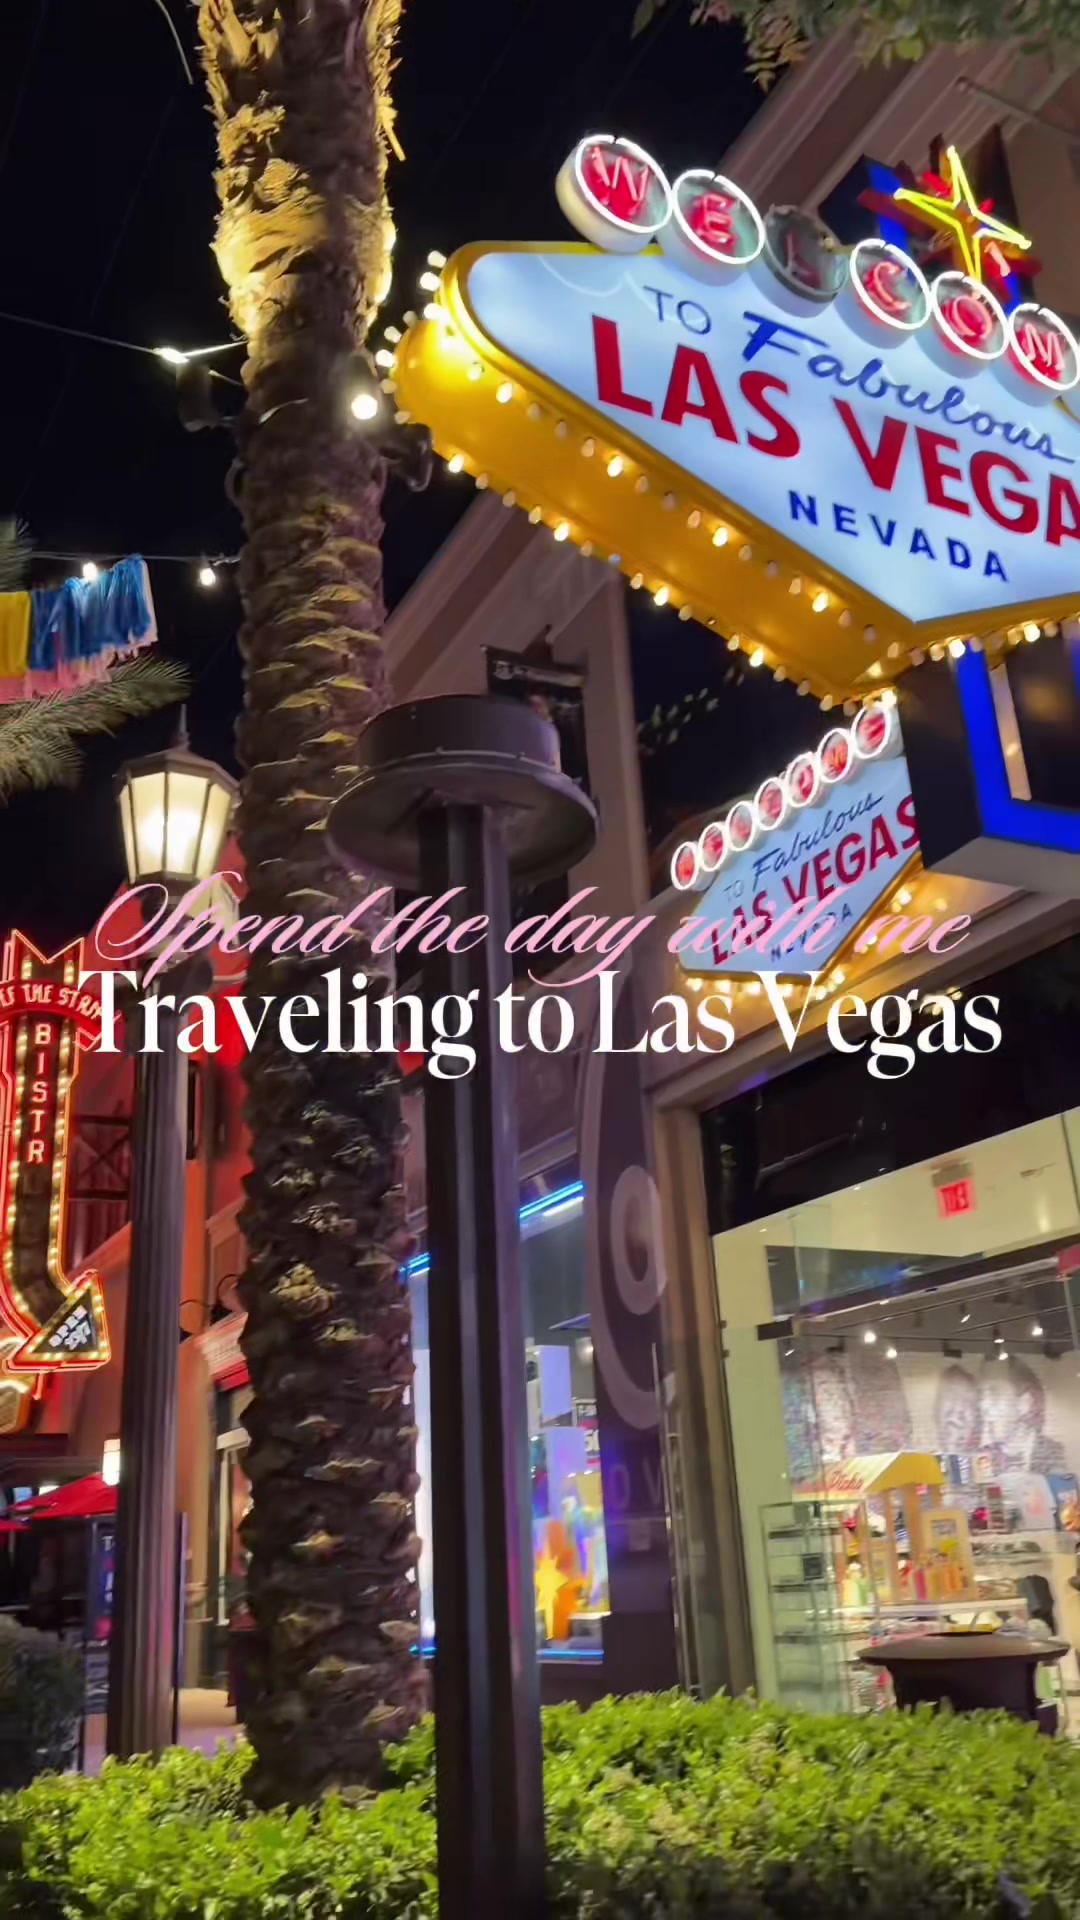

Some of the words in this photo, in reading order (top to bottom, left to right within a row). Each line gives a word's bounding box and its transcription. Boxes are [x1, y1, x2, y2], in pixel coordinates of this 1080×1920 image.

[591, 313, 802, 458] LAS
[642, 285, 712, 335] TO
[742, 310, 1076, 465] Fabulous
[787, 489, 1010, 583] NEVADA
[722, 879, 745, 903] TO
[751, 791, 885, 892] Fabulous
[782, 793, 920, 912] VEGAS
